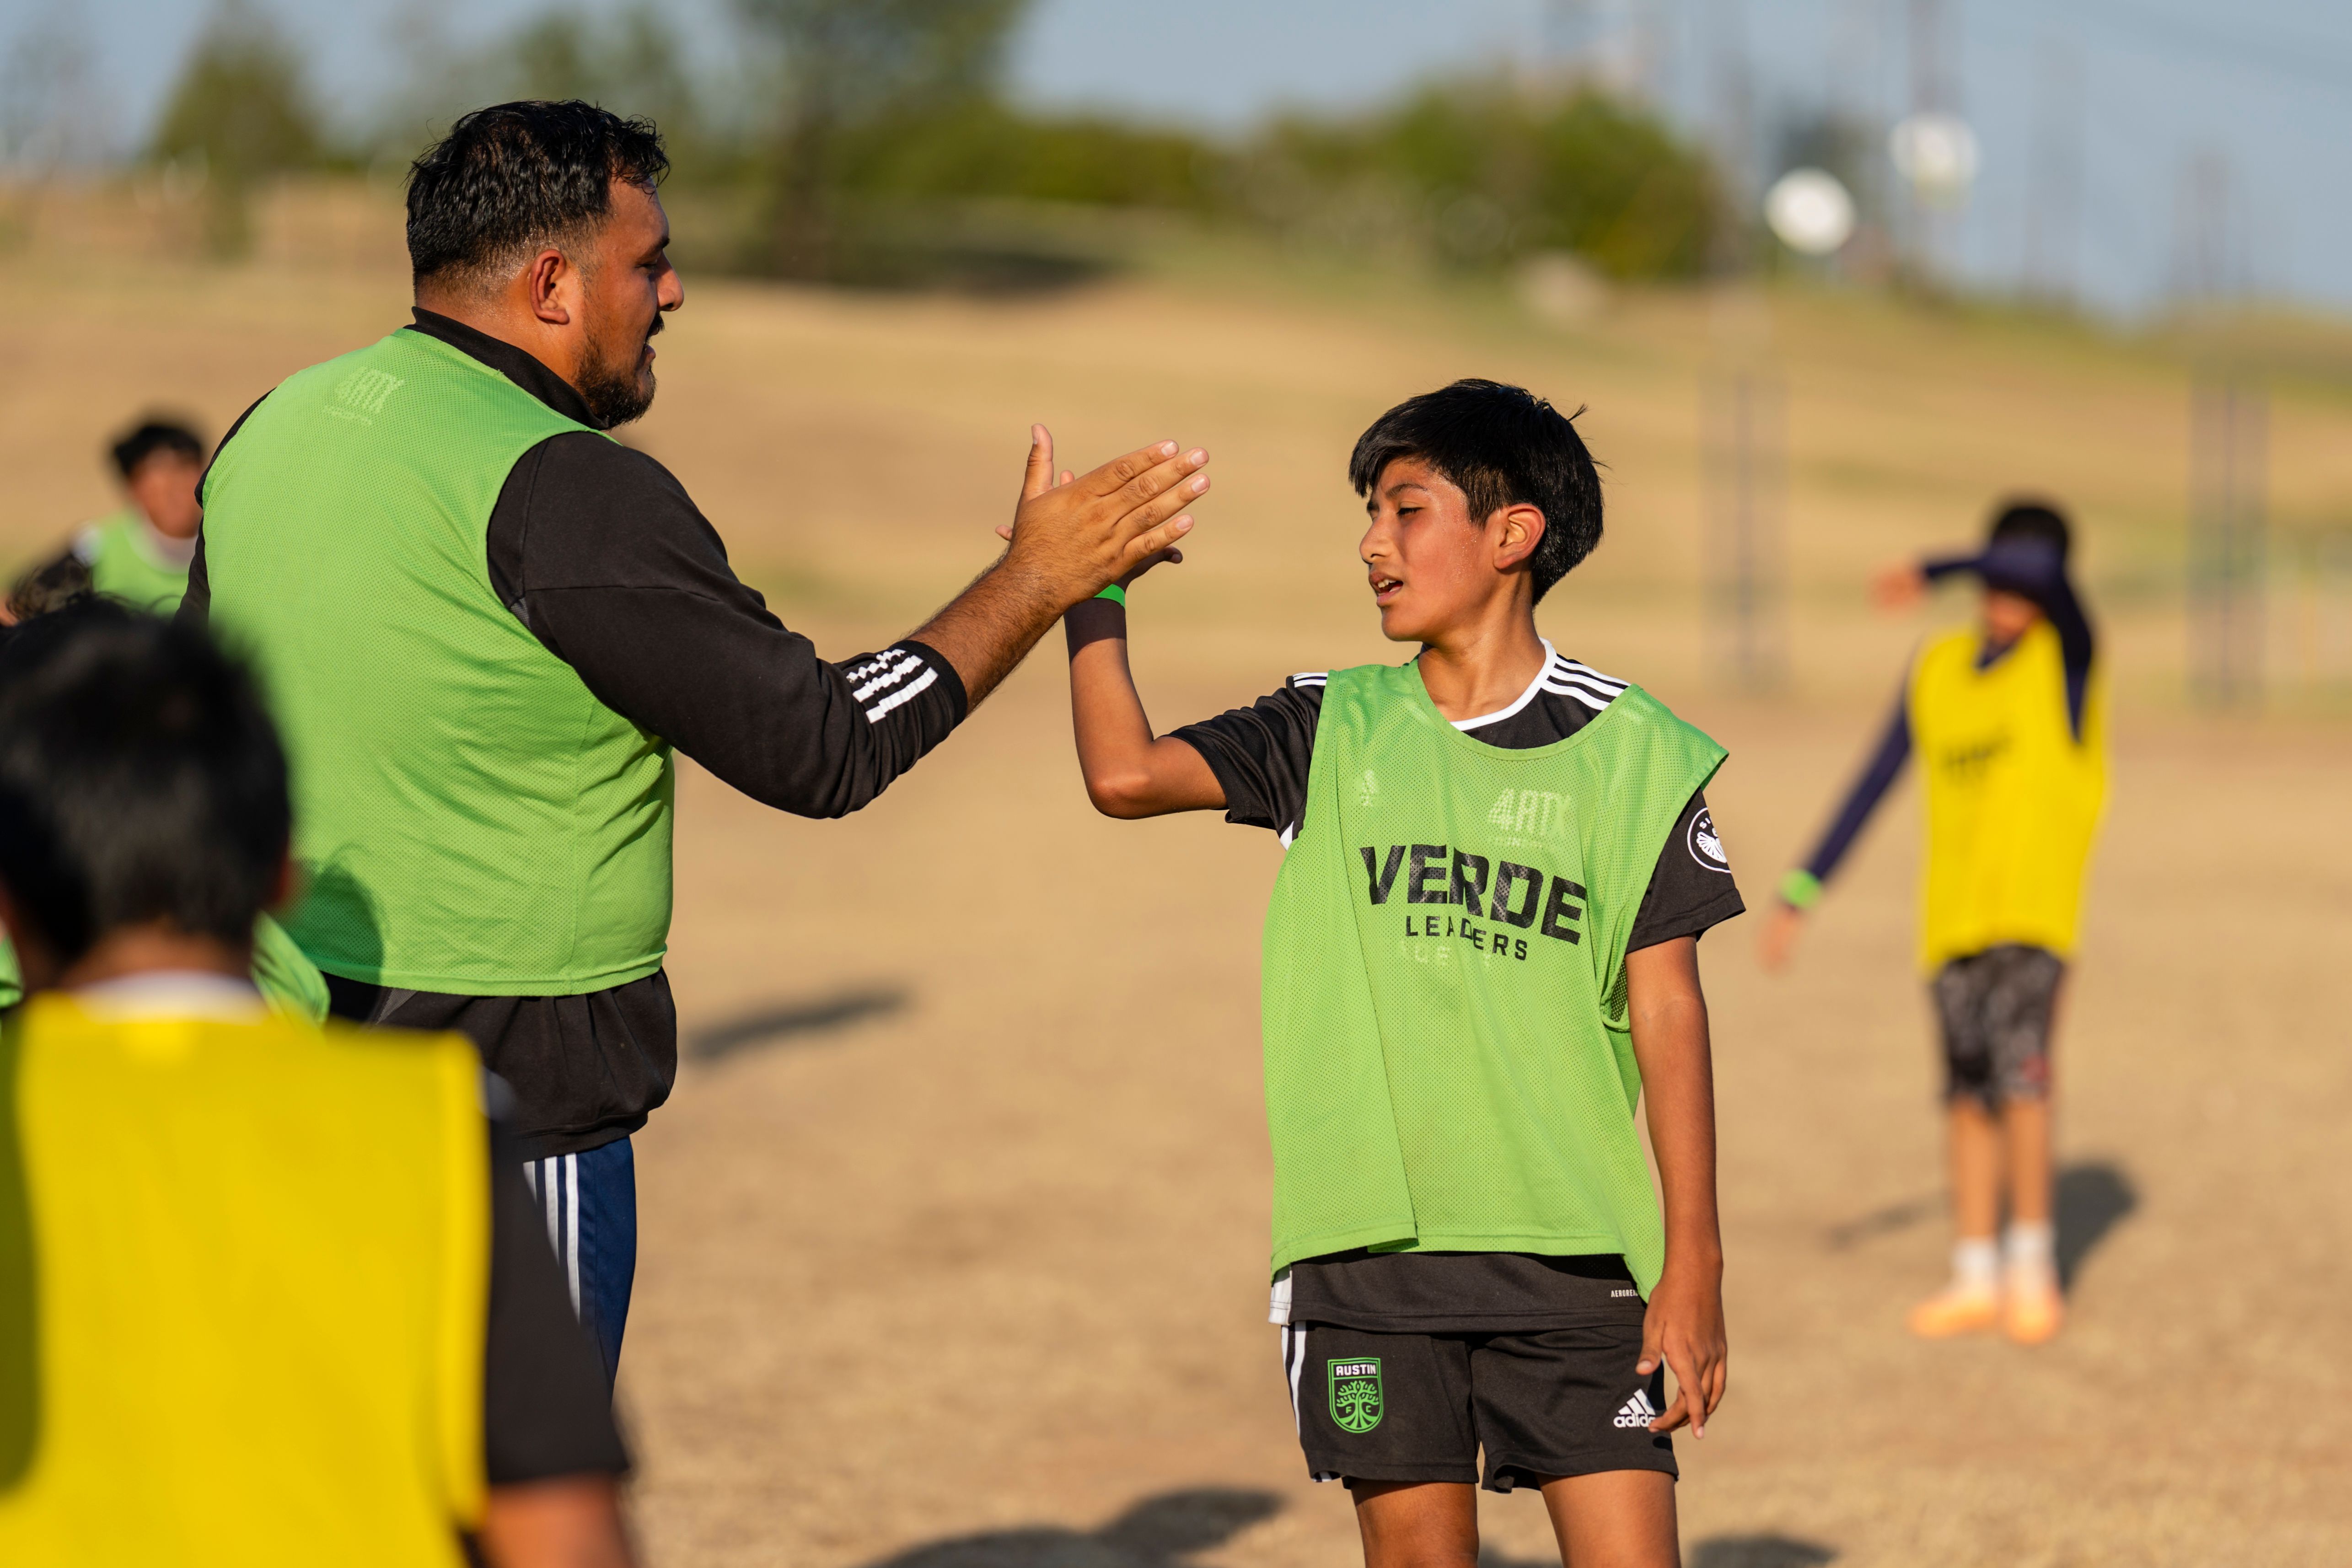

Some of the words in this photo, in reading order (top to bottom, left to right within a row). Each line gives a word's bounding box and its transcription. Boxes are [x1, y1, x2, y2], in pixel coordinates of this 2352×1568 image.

[1359, 843, 1588, 945] VERDE
[1405, 915, 1528, 961] LEADERS
[1336, 1364, 1376, 1376] AUSTIN
